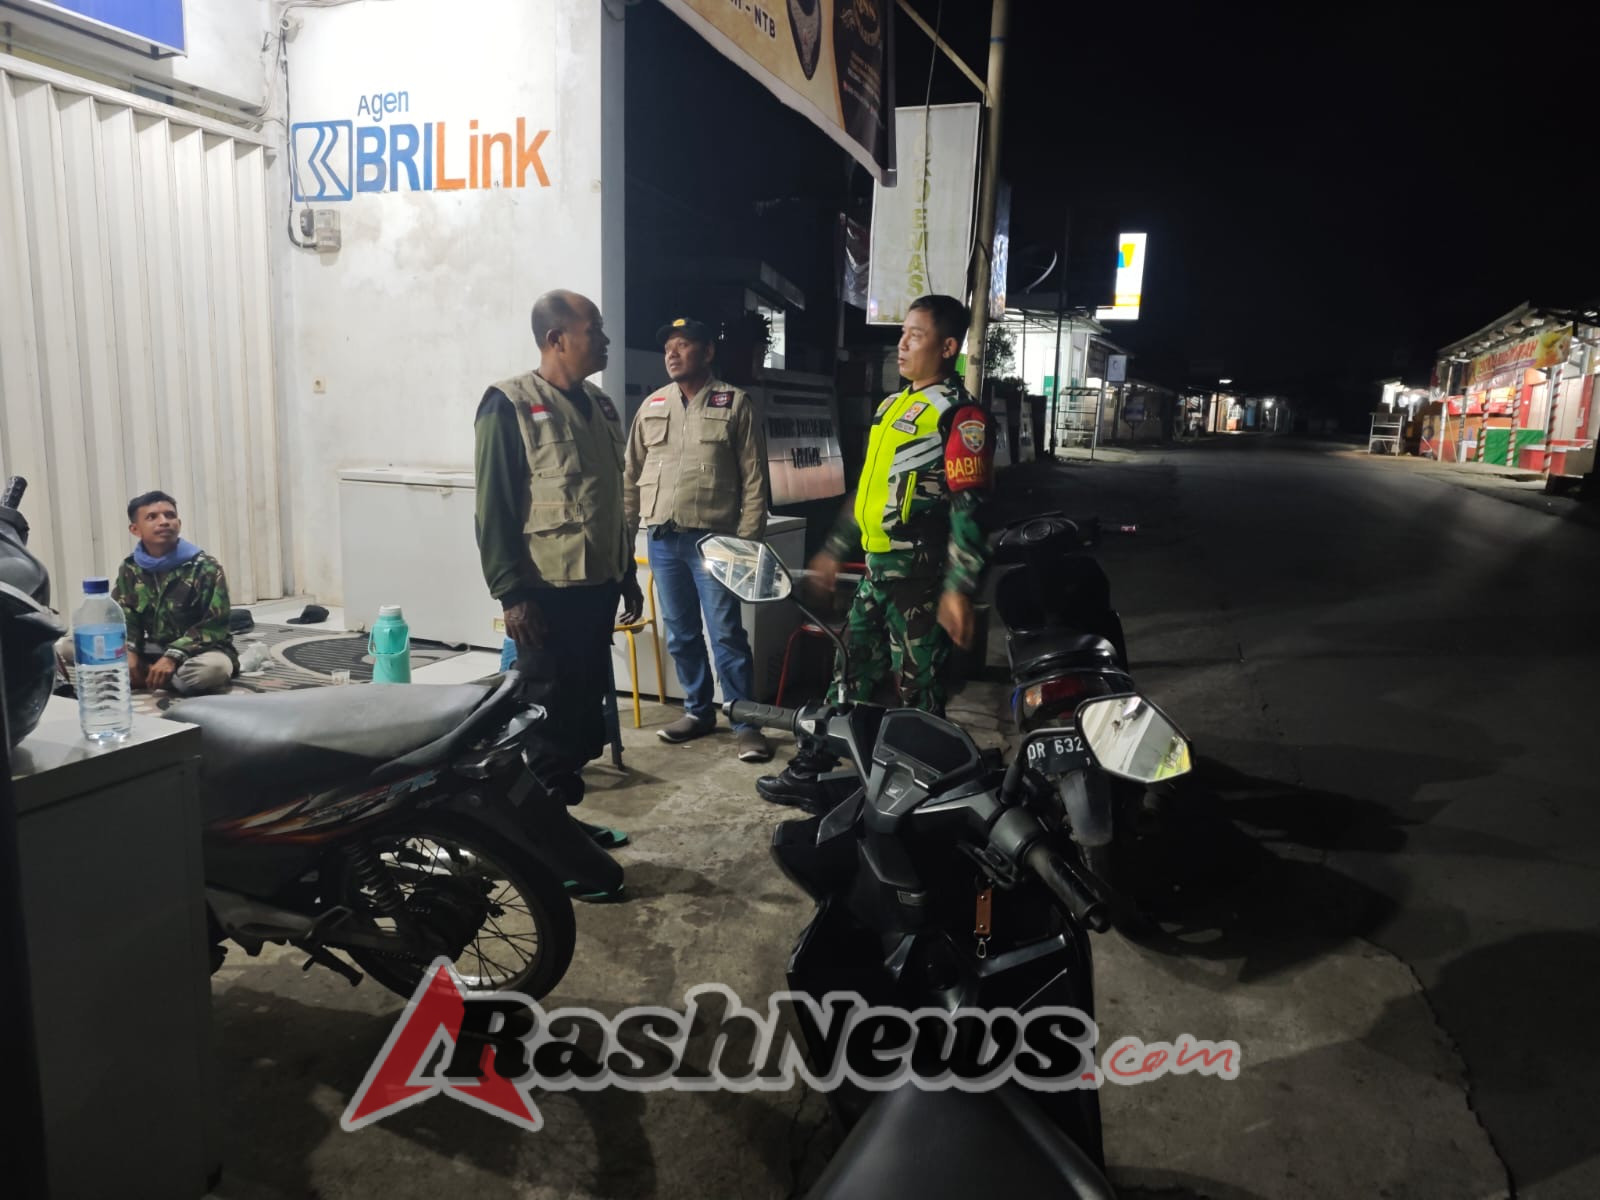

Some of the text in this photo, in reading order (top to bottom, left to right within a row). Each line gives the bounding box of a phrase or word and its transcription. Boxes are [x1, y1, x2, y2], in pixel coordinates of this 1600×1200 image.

[754, 4, 776, 38] NTB
[357, 90, 409, 122] Agen
[356, 116, 552, 193] BRILink
[1054, 736, 1084, 754] 632
